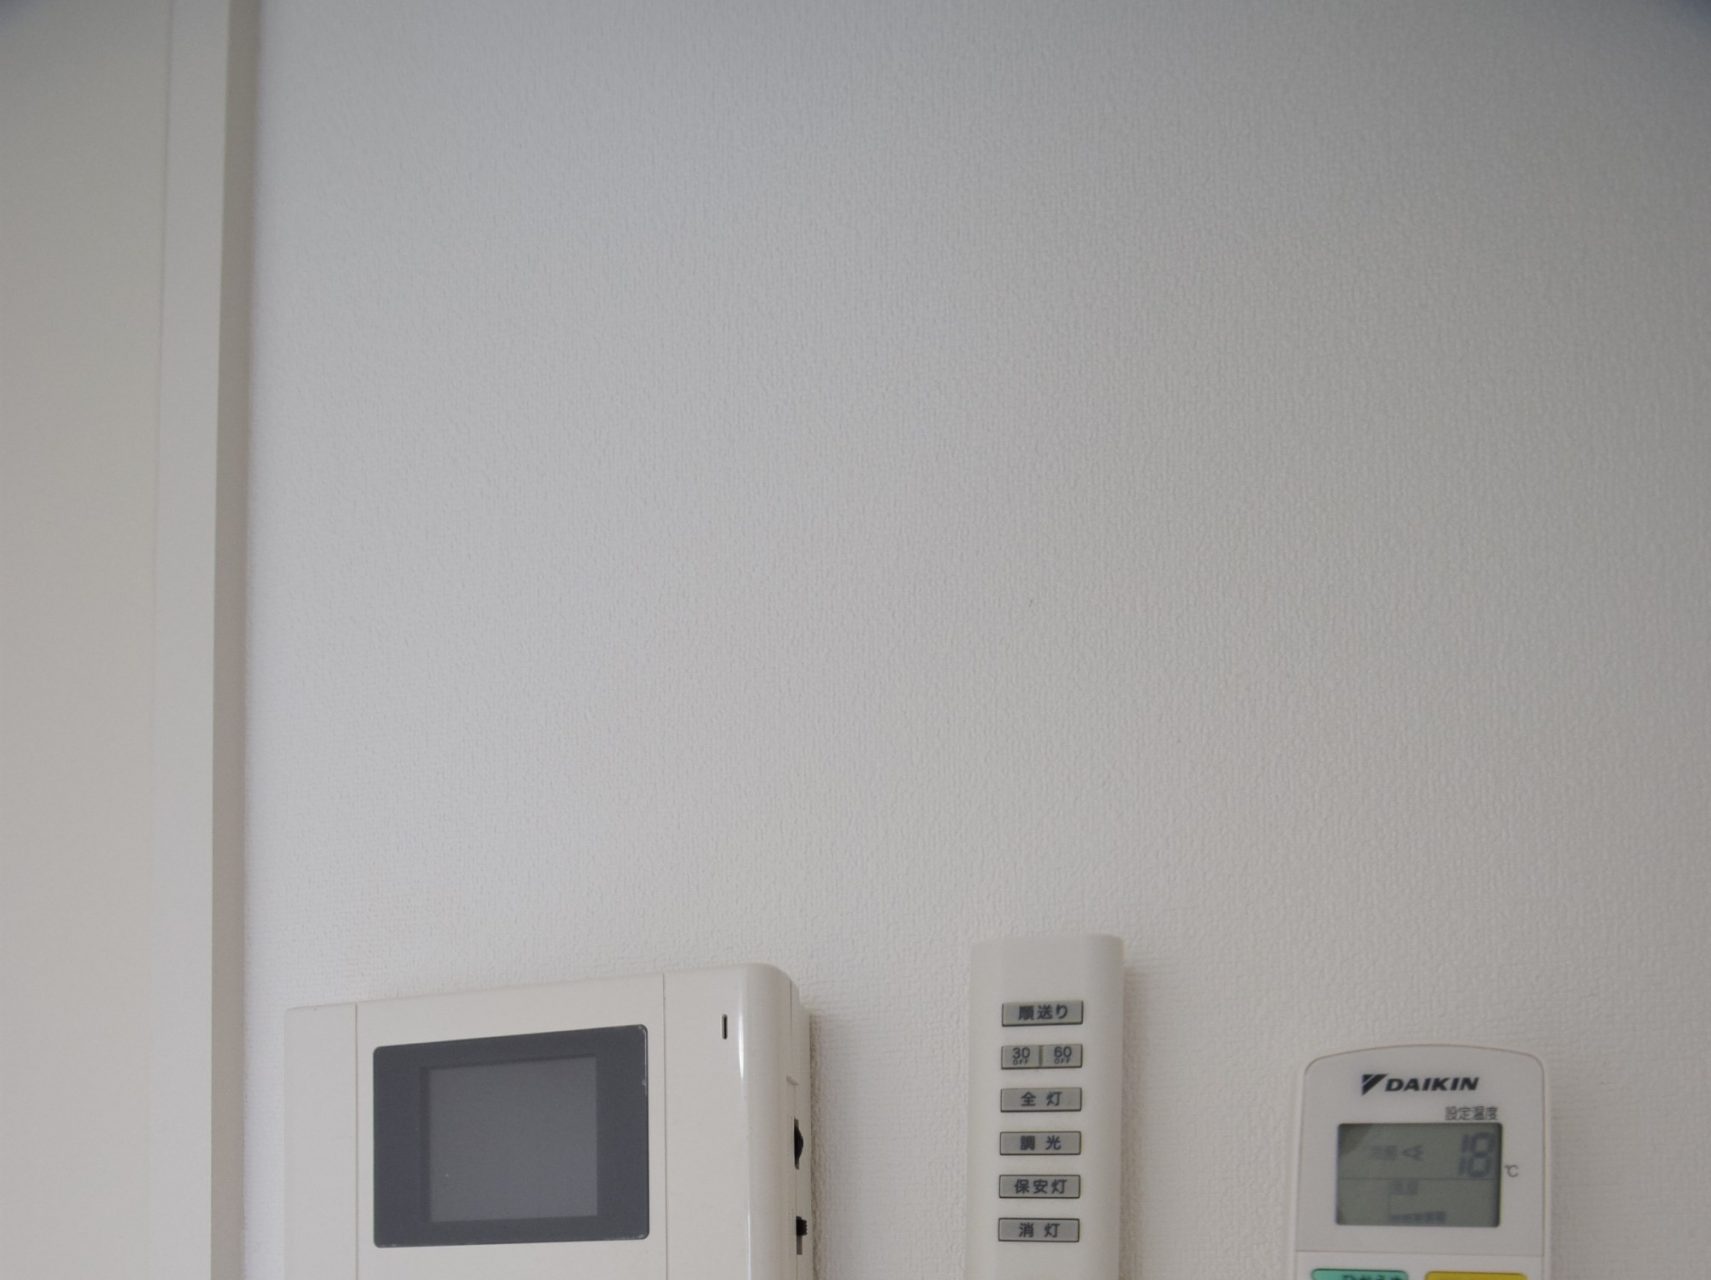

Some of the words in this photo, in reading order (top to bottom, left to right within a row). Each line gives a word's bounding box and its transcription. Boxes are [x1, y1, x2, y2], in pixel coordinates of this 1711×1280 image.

[1019, 1004, 1069, 1020] 順送り
[1012, 1047, 1031, 1059] 30
[1053, 1047, 1073, 1059] 60
[1385, 1076, 1480, 1093] DAIKIN
[1021, 1091, 1062, 1107] 全灯
[1445, 1106, 1499, 1121] 設定温度
[1020, 1135, 1062, 1151] 調光
[1014, 1178, 1067, 1195] 保安灯
[1019, 1222, 1060, 1238] 消灯
